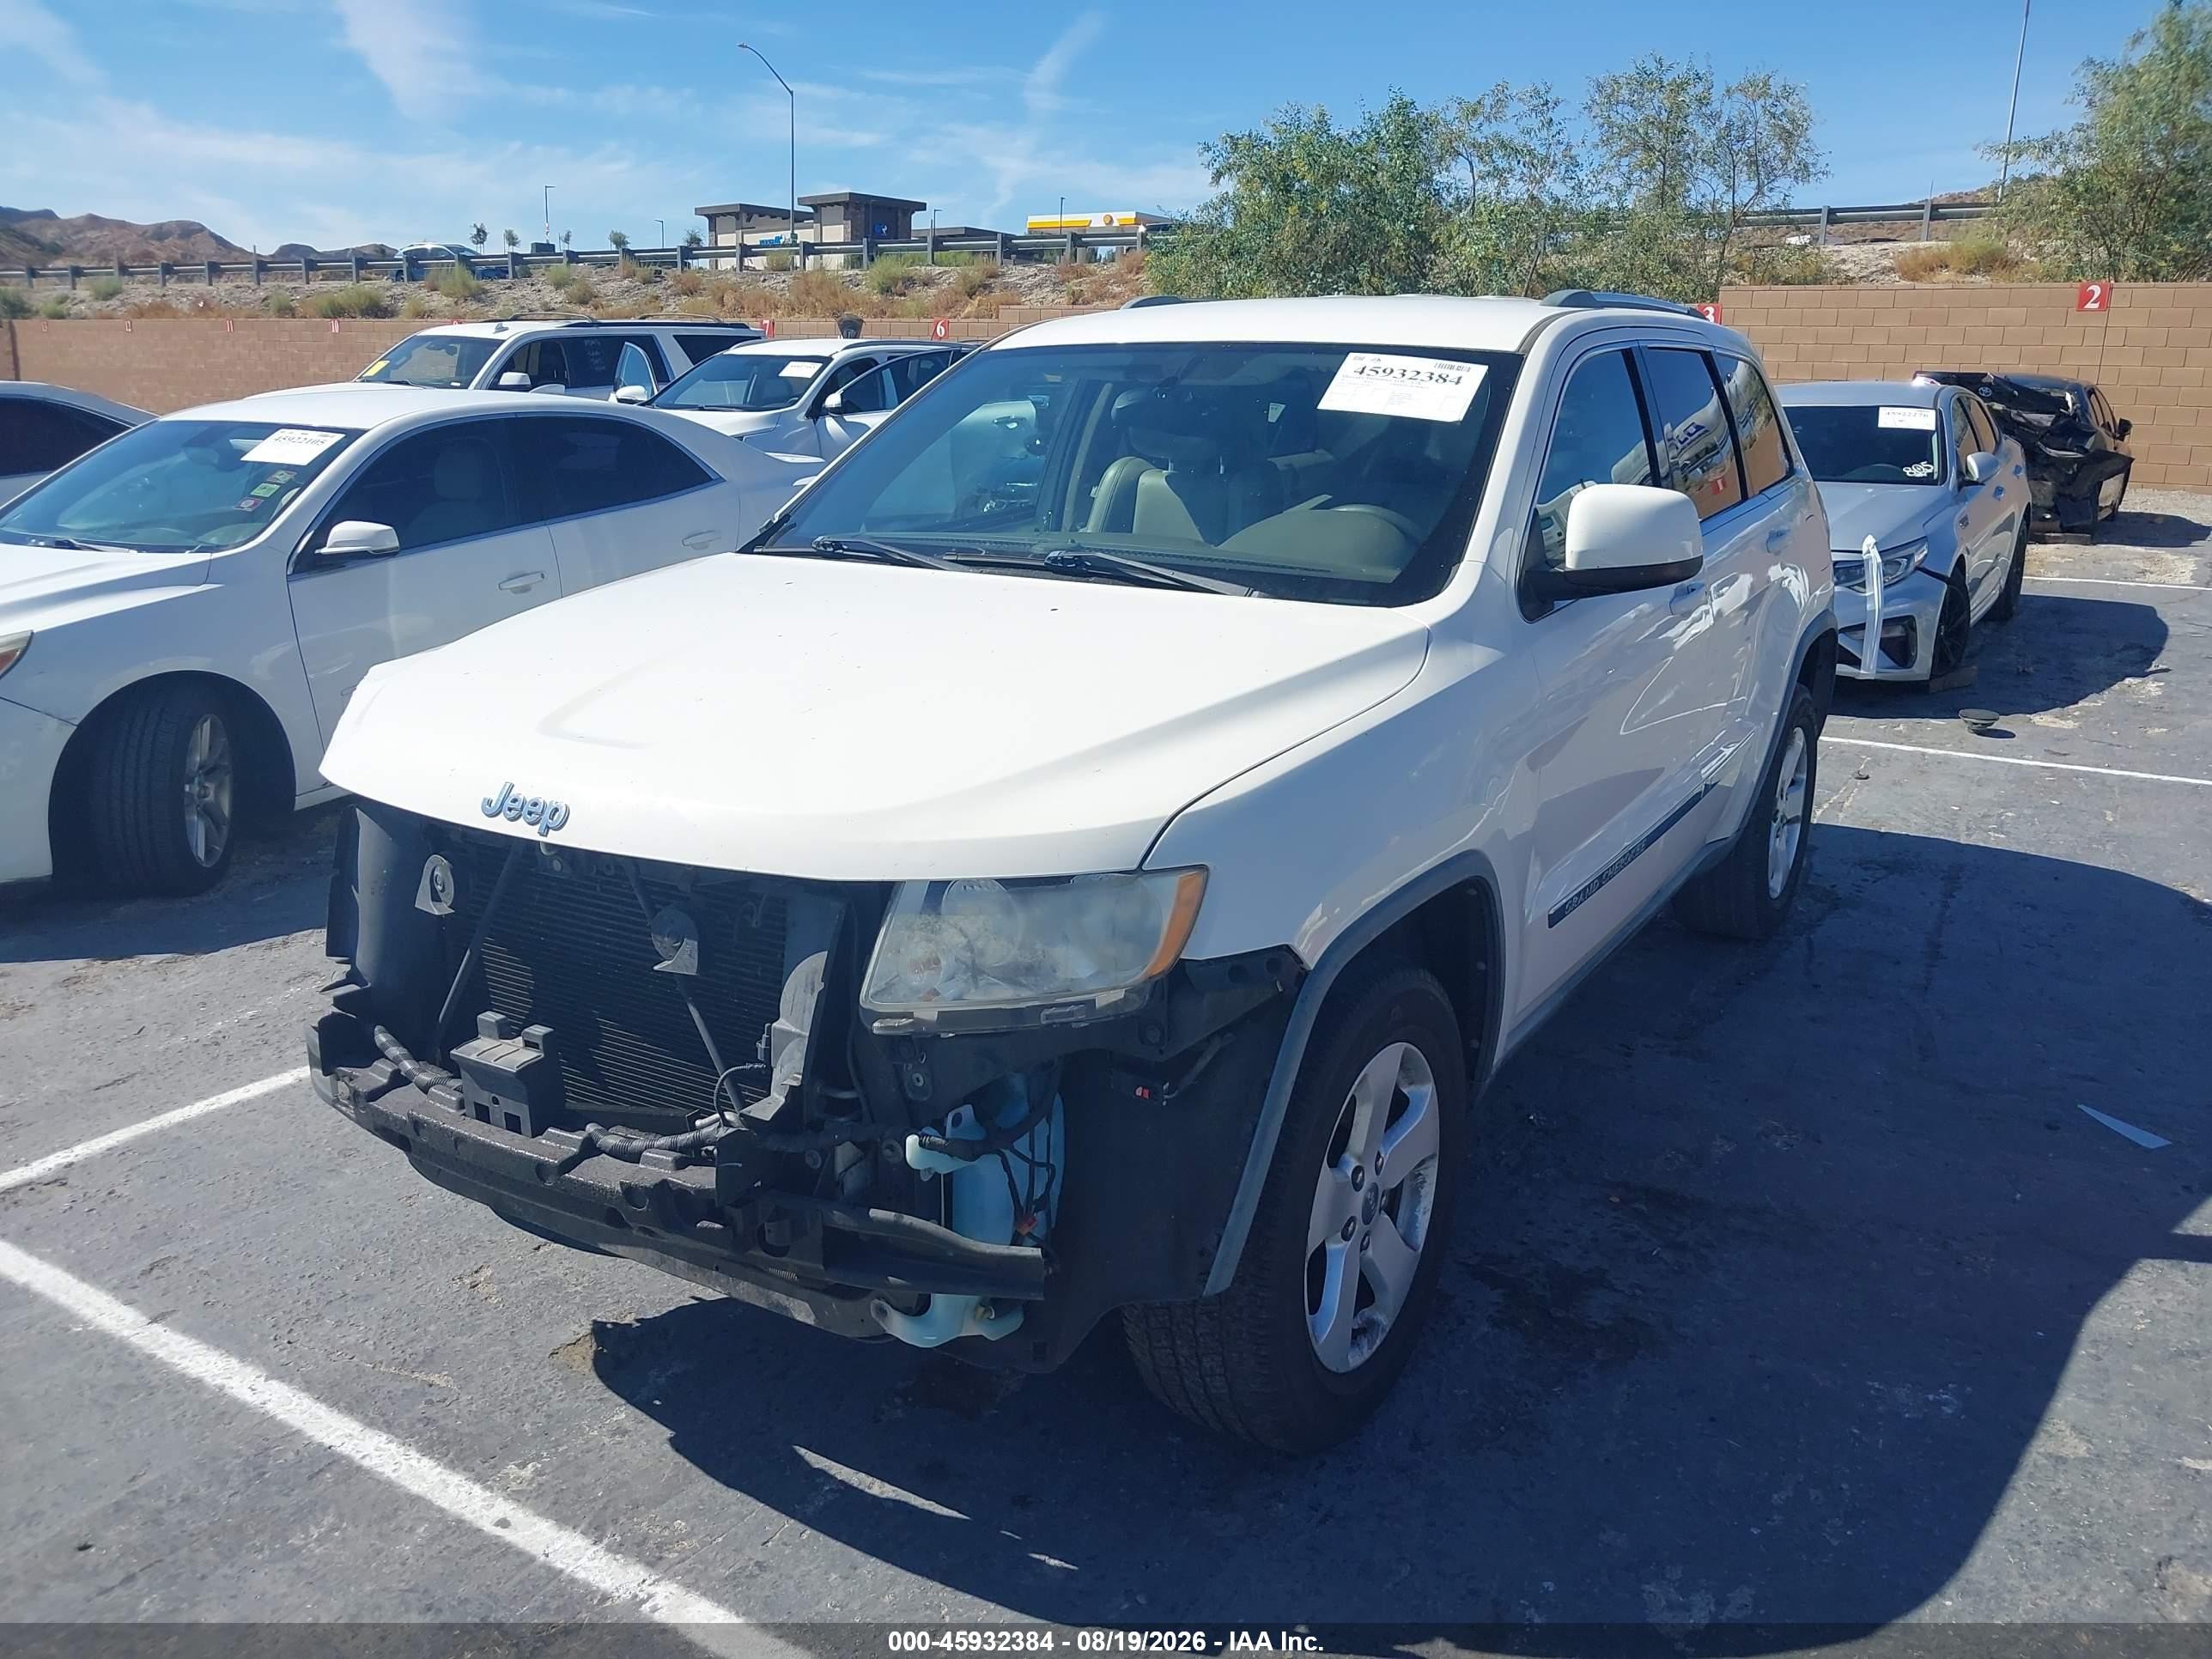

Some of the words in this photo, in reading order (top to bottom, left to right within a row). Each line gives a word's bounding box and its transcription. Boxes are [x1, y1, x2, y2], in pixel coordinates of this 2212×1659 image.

[2083, 284, 2101, 309] 2
[1704, 306, 1715, 323] 3
[331, 320, 339, 333] 10
[763, 319, 769, 336] 7
[936, 319, 945, 337] 6
[1353, 364, 1464, 386] 45932384
[1903, 461, 1934, 477] 805
[481, 781, 570, 837] Jeep
[1565, 879, 1601, 915] GRAND
